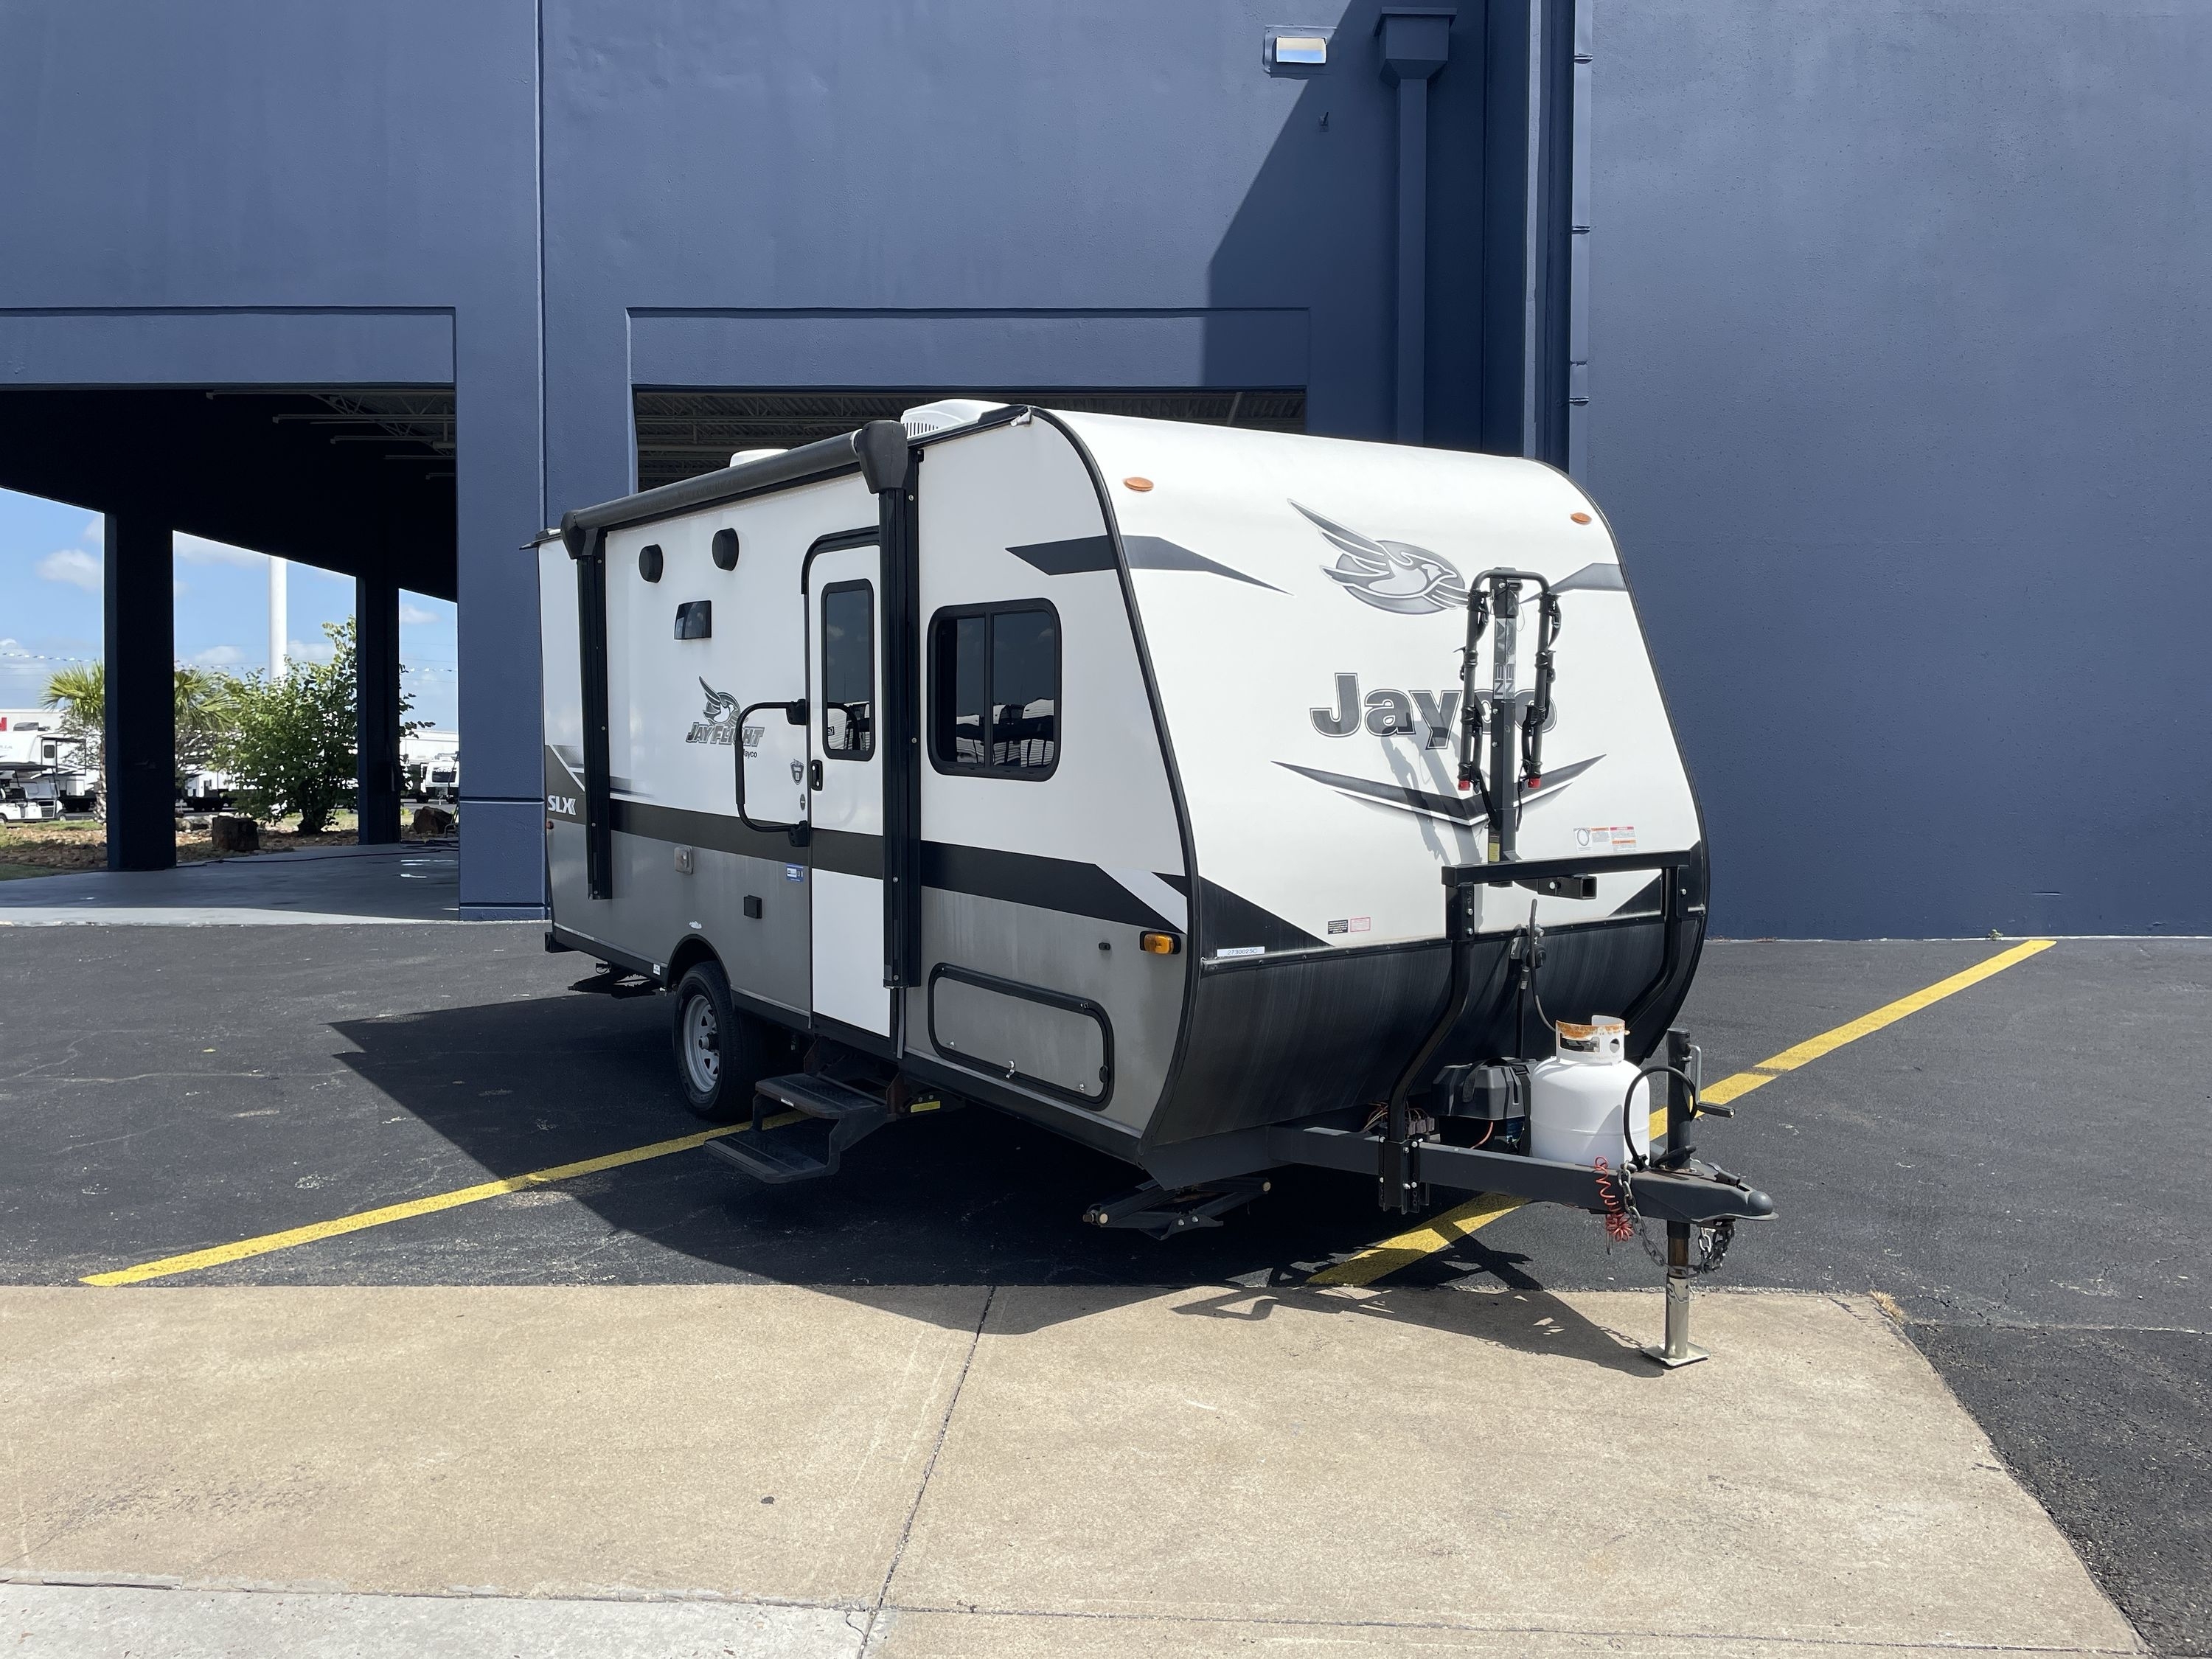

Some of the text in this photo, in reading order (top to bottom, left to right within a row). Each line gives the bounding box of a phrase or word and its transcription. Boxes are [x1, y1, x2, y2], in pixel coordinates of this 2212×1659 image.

[686, 722, 765, 747] JAY FLIHT
[742, 748, 758, 759] ayco
[548, 795, 577, 815] SLX
